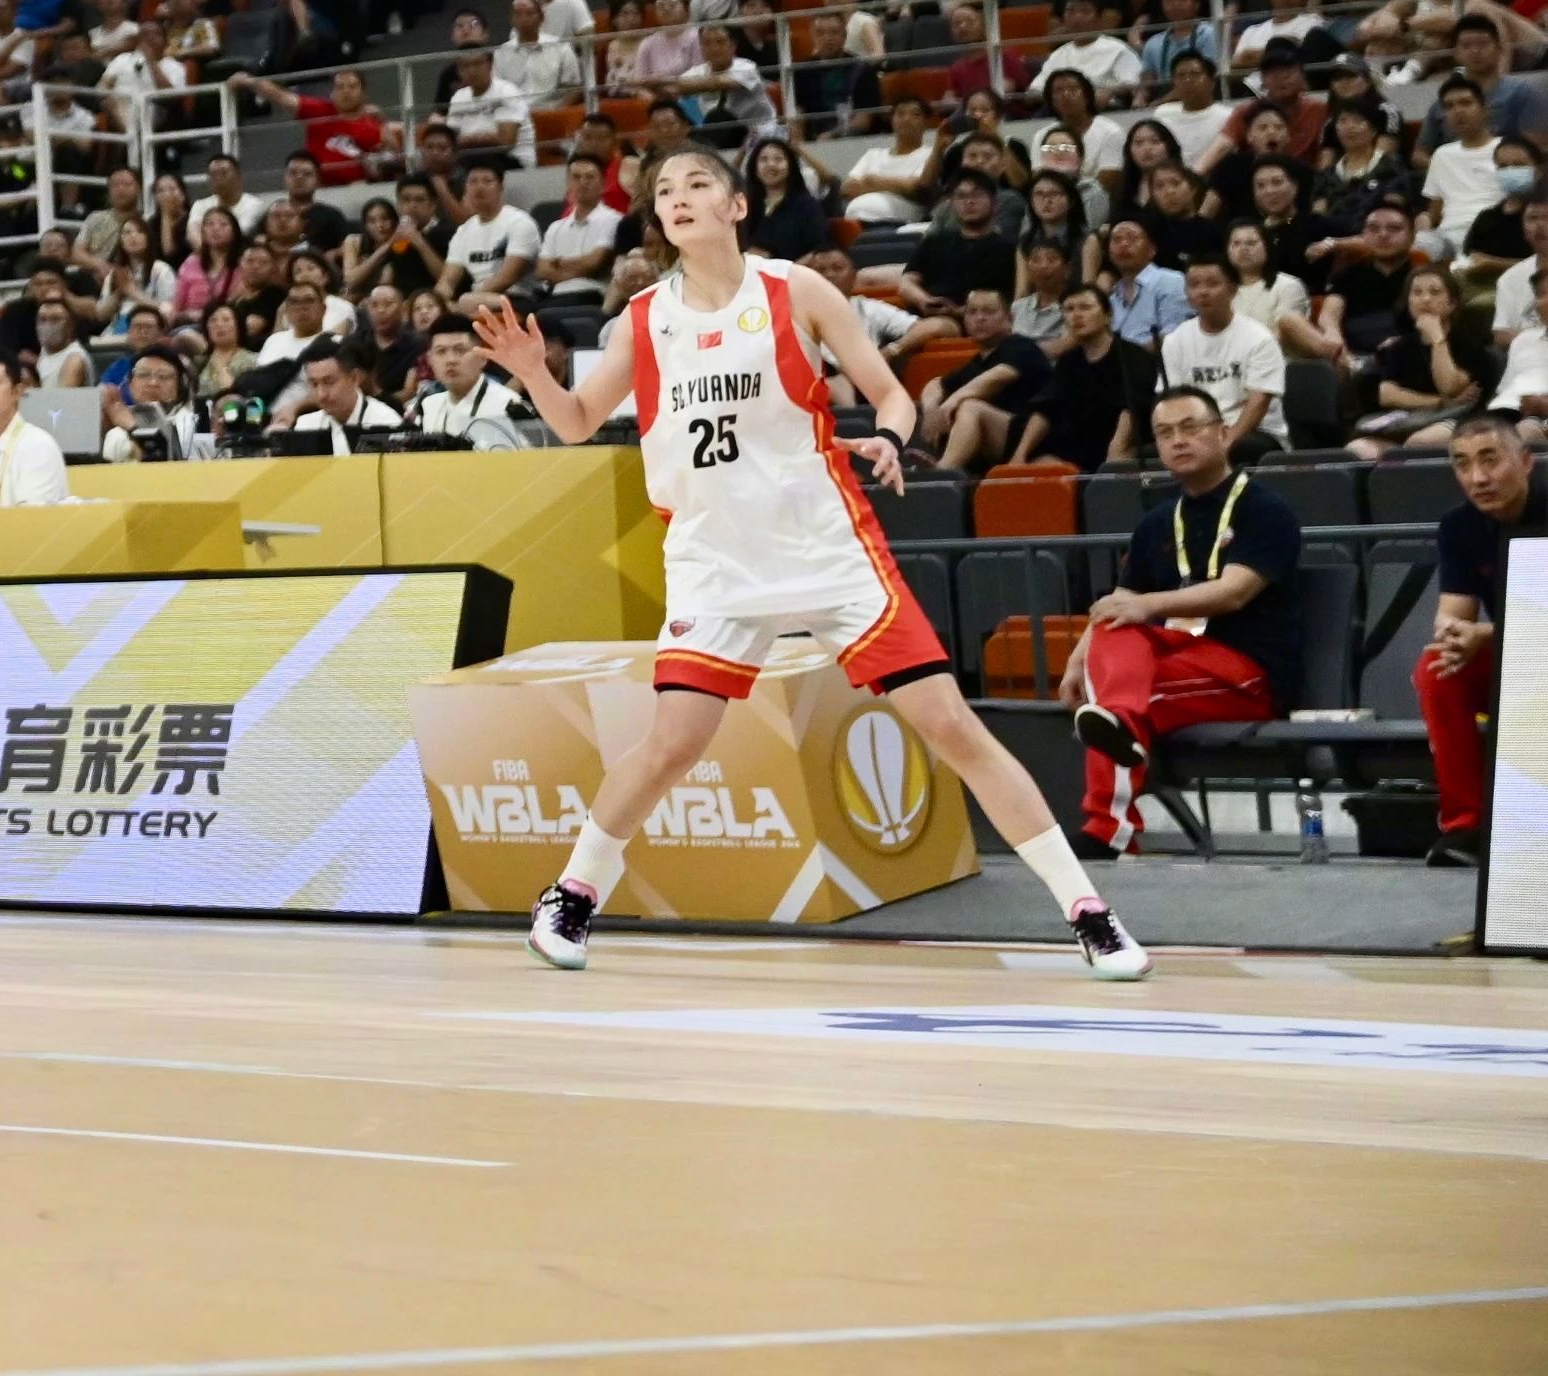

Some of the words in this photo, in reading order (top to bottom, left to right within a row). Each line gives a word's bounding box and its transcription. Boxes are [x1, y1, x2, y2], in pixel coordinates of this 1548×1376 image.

[672, 372, 762, 413] SC.YUANDA
[688, 414, 740, 469] 25
[492, 759, 530, 782] FIBA
[46, 809, 220, 839] LOTTERY
[441, 784, 590, 834] WBLA
[642, 786, 798, 838] WBLA
